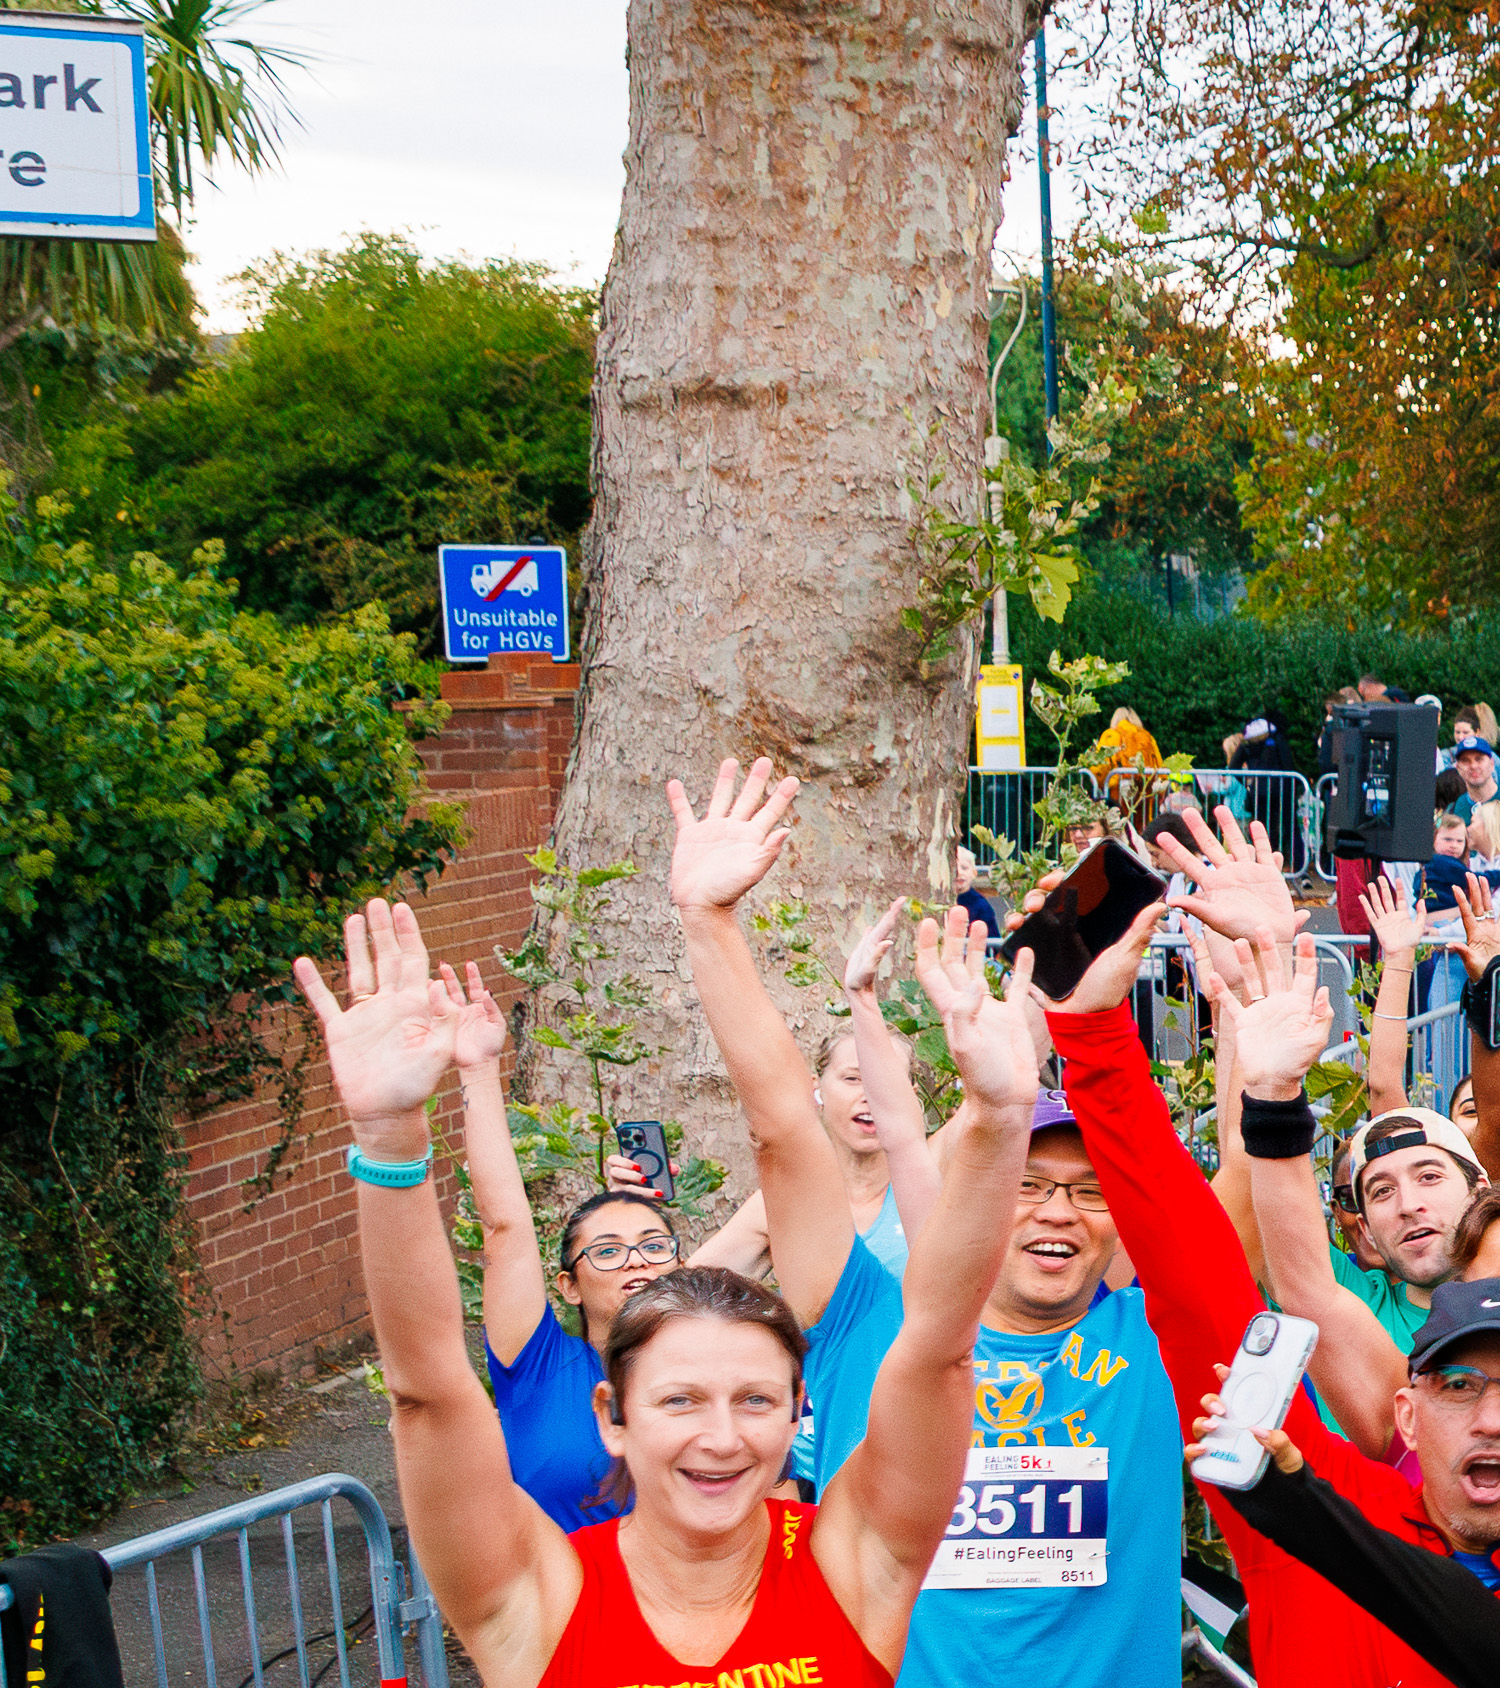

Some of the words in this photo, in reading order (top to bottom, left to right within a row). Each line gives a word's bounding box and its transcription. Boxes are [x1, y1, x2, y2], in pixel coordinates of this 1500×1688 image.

[453, 607, 558, 627] Unsuitable
[461, 631, 490, 649] for
[500, 631, 553, 649] HGVs
[985, 1455, 1018, 1464] EALING
[1020, 1455, 1042, 1470] 5k
[954, 1547, 1074, 1562] #EalingFeeling
[1061, 1570, 1095, 1582] 8511
